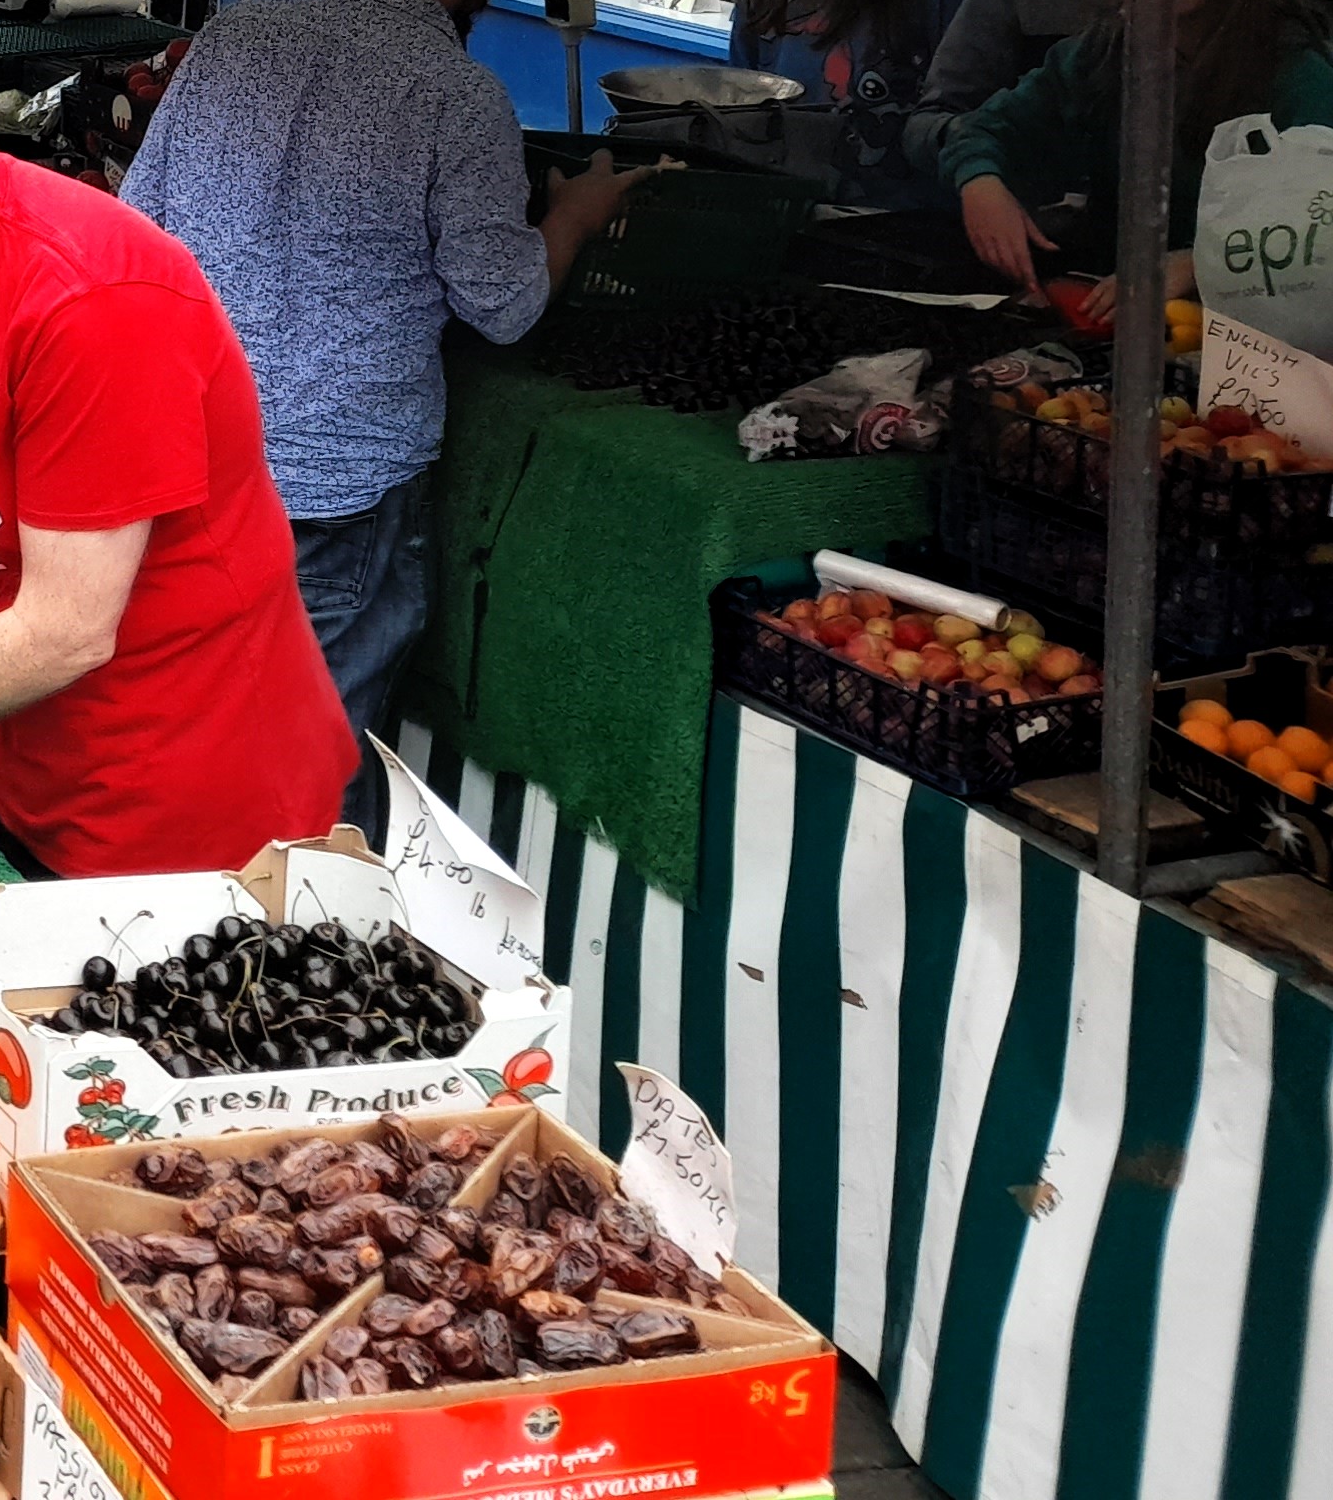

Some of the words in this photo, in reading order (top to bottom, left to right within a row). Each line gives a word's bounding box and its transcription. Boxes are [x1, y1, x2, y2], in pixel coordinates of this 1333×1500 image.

[1224, 223, 1318, 297] epi
[1208, 319, 1299, 368] ENGLISH
[174, 1084, 290, 1126] Fresh
[307, 1075, 464, 1113] Produce
[748, 1379, 777, 1405] kg
[785, 1369, 810, 1417] 5
[563, 1468, 699, 1500] EVERYDAY'S
